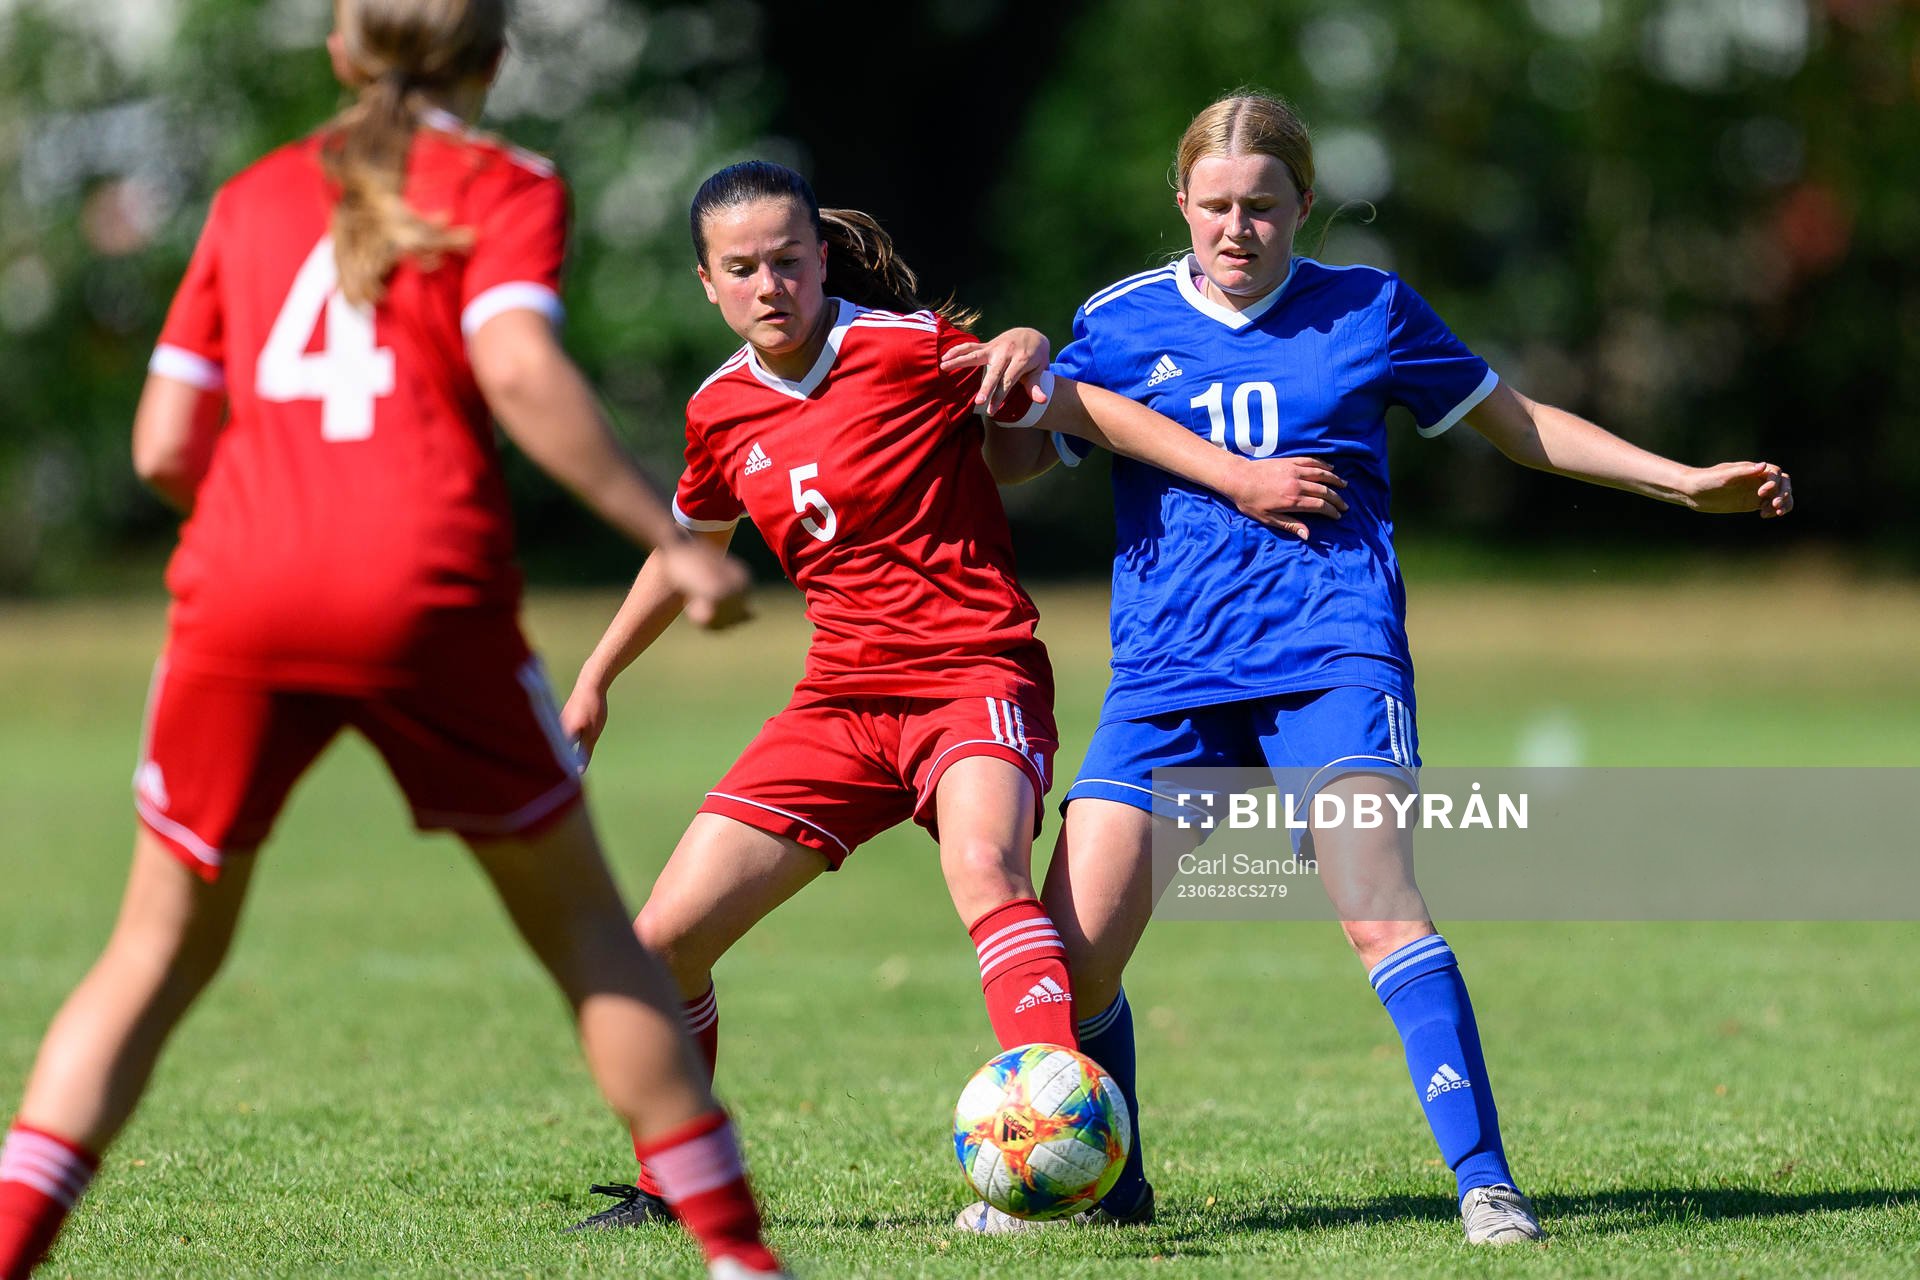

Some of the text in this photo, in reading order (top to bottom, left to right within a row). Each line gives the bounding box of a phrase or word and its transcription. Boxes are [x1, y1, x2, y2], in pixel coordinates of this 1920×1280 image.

[254, 231, 396, 442] 4
[1147, 368, 1183, 387] adidas
[1189, 381, 1279, 458] 10
[744, 457, 772, 476] adidas
[789, 462, 837, 543] 5
[1014, 992, 1072, 1014] adidas
[1426, 1080, 1471, 1102] adidas
